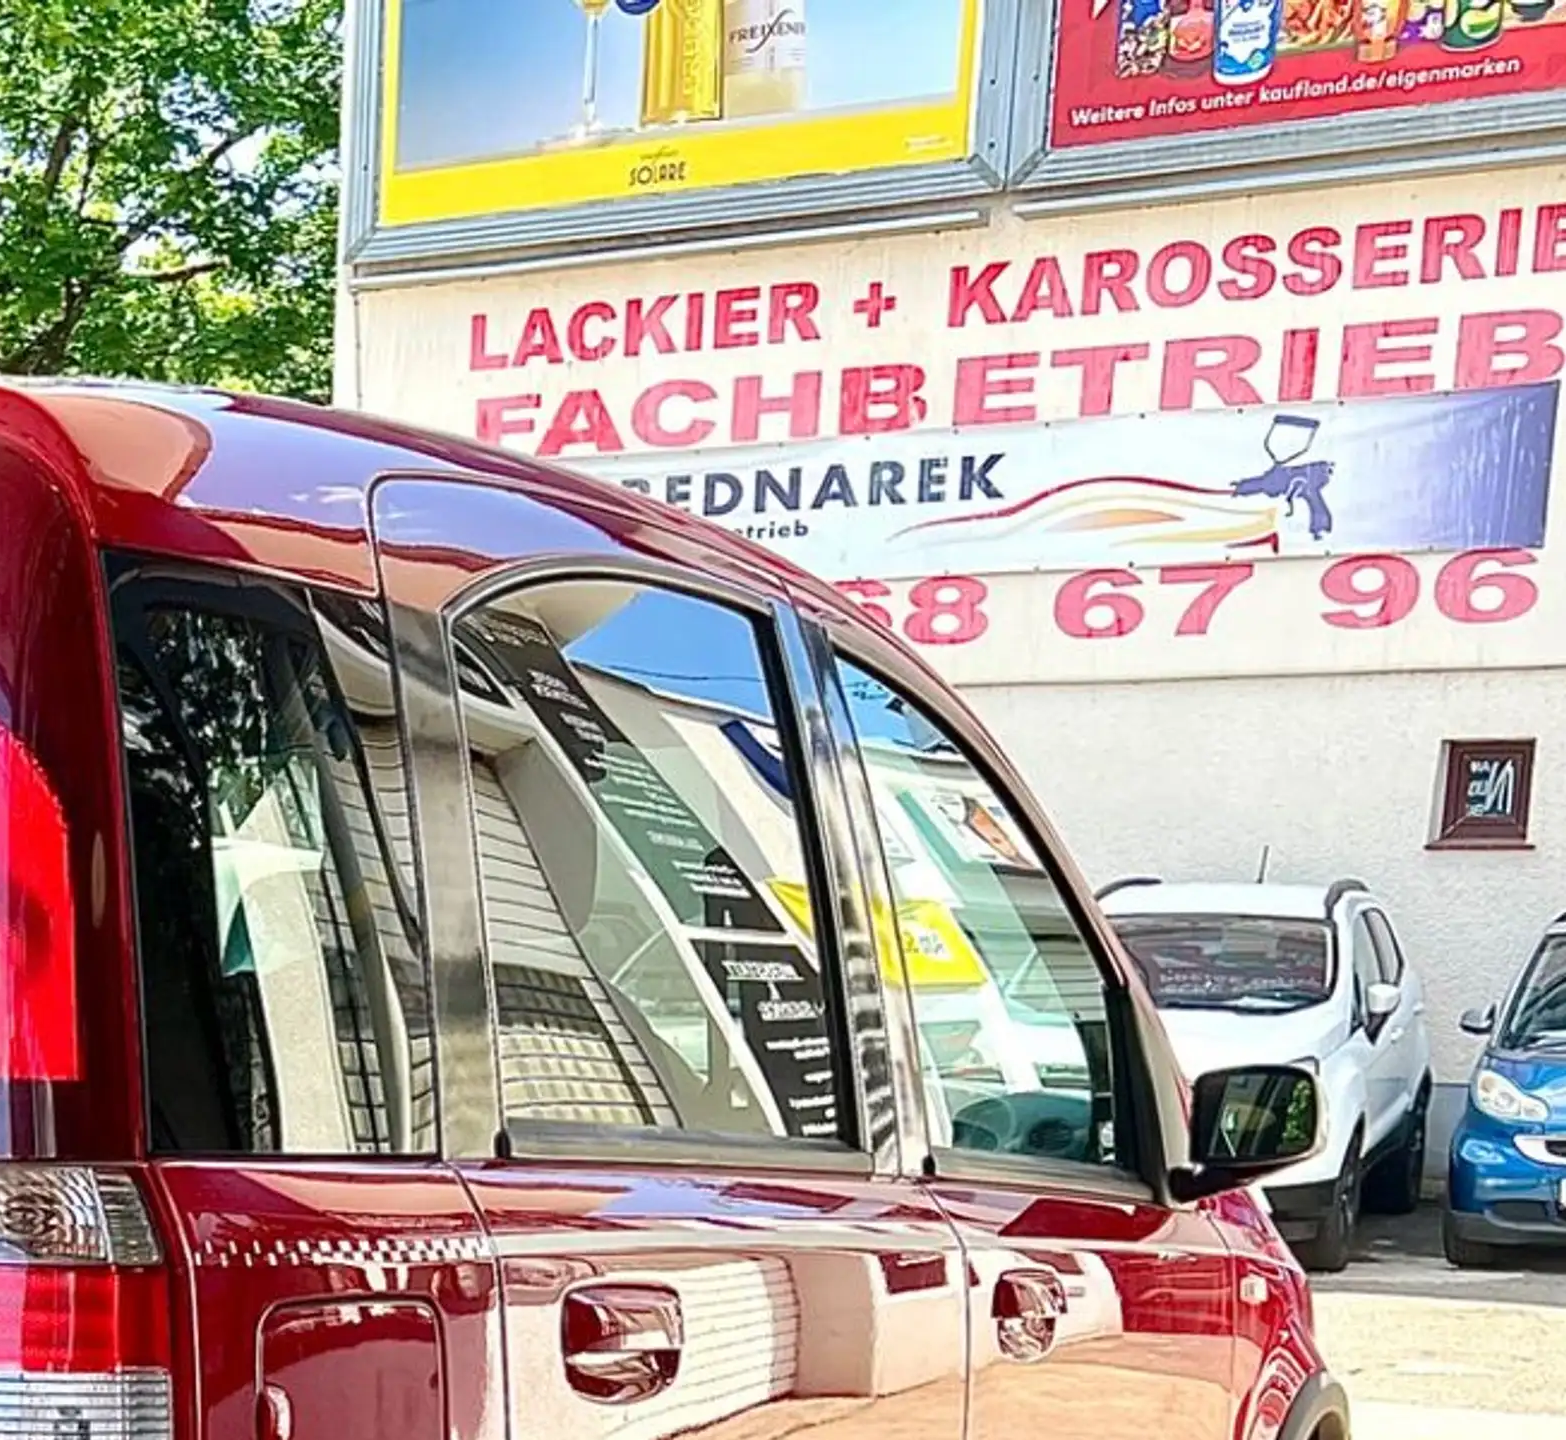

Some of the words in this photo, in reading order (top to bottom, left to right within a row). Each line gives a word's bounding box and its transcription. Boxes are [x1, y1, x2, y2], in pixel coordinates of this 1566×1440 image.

[1070, 105, 1145, 126] Weitere
[1148, 97, 1196, 117] Infos
[1201, 91, 1255, 110] unter
[1258, 57, 1520, 102] kaufland.de/eigenmarken
[469, 282, 821, 371] LACKIER
[854, 281, 896, 328] +
[947, 203, 1566, 327] KAROSSERIE
[475, 308, 1565, 457] FACHBETRIEB
[1053, 563, 1256, 639] 67
[1320, 547, 1540, 630] 96
